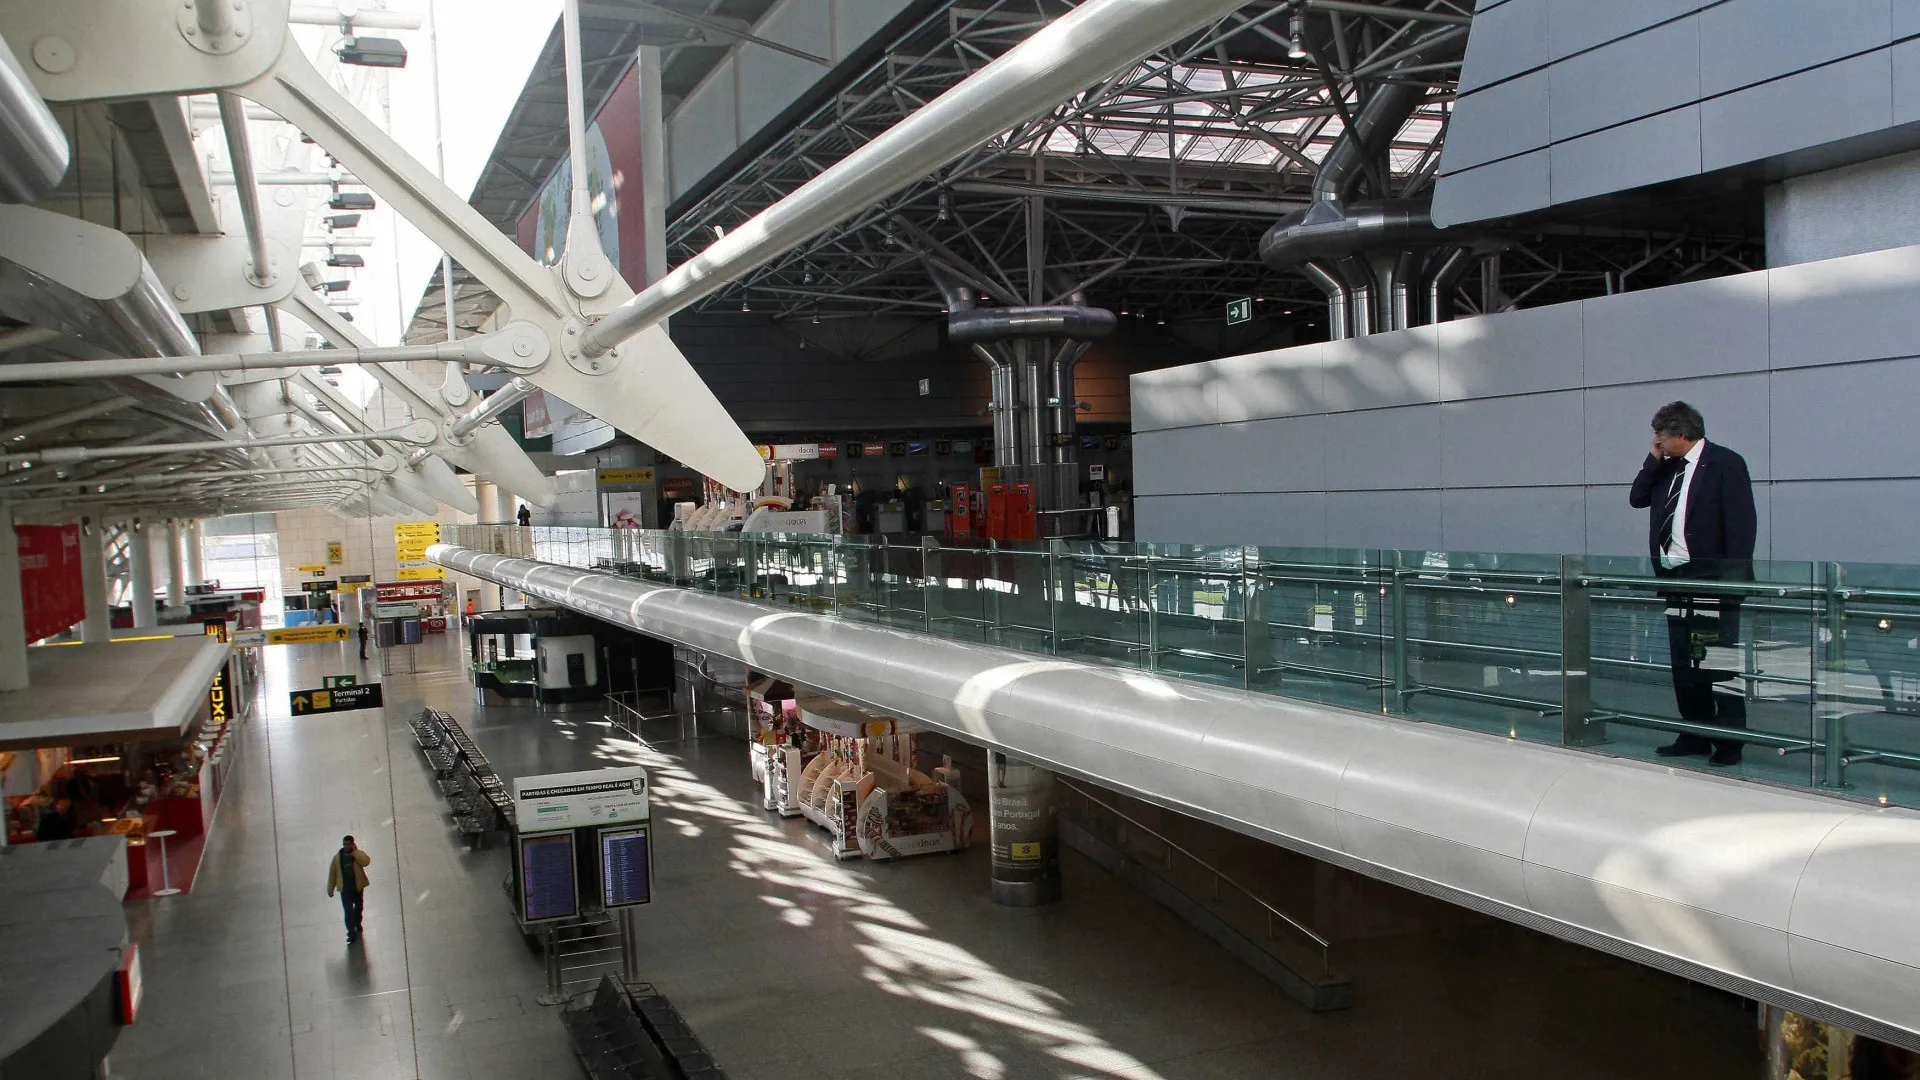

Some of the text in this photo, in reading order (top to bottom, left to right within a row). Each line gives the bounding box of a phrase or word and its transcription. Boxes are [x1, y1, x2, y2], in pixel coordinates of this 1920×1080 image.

[333, 687, 370, 698] Terminal 2
[522, 789, 547, 797] PARTIDAS
[550, 787, 577, 795] CHEGADAS
[1003, 809, 1040, 820] Portugal
